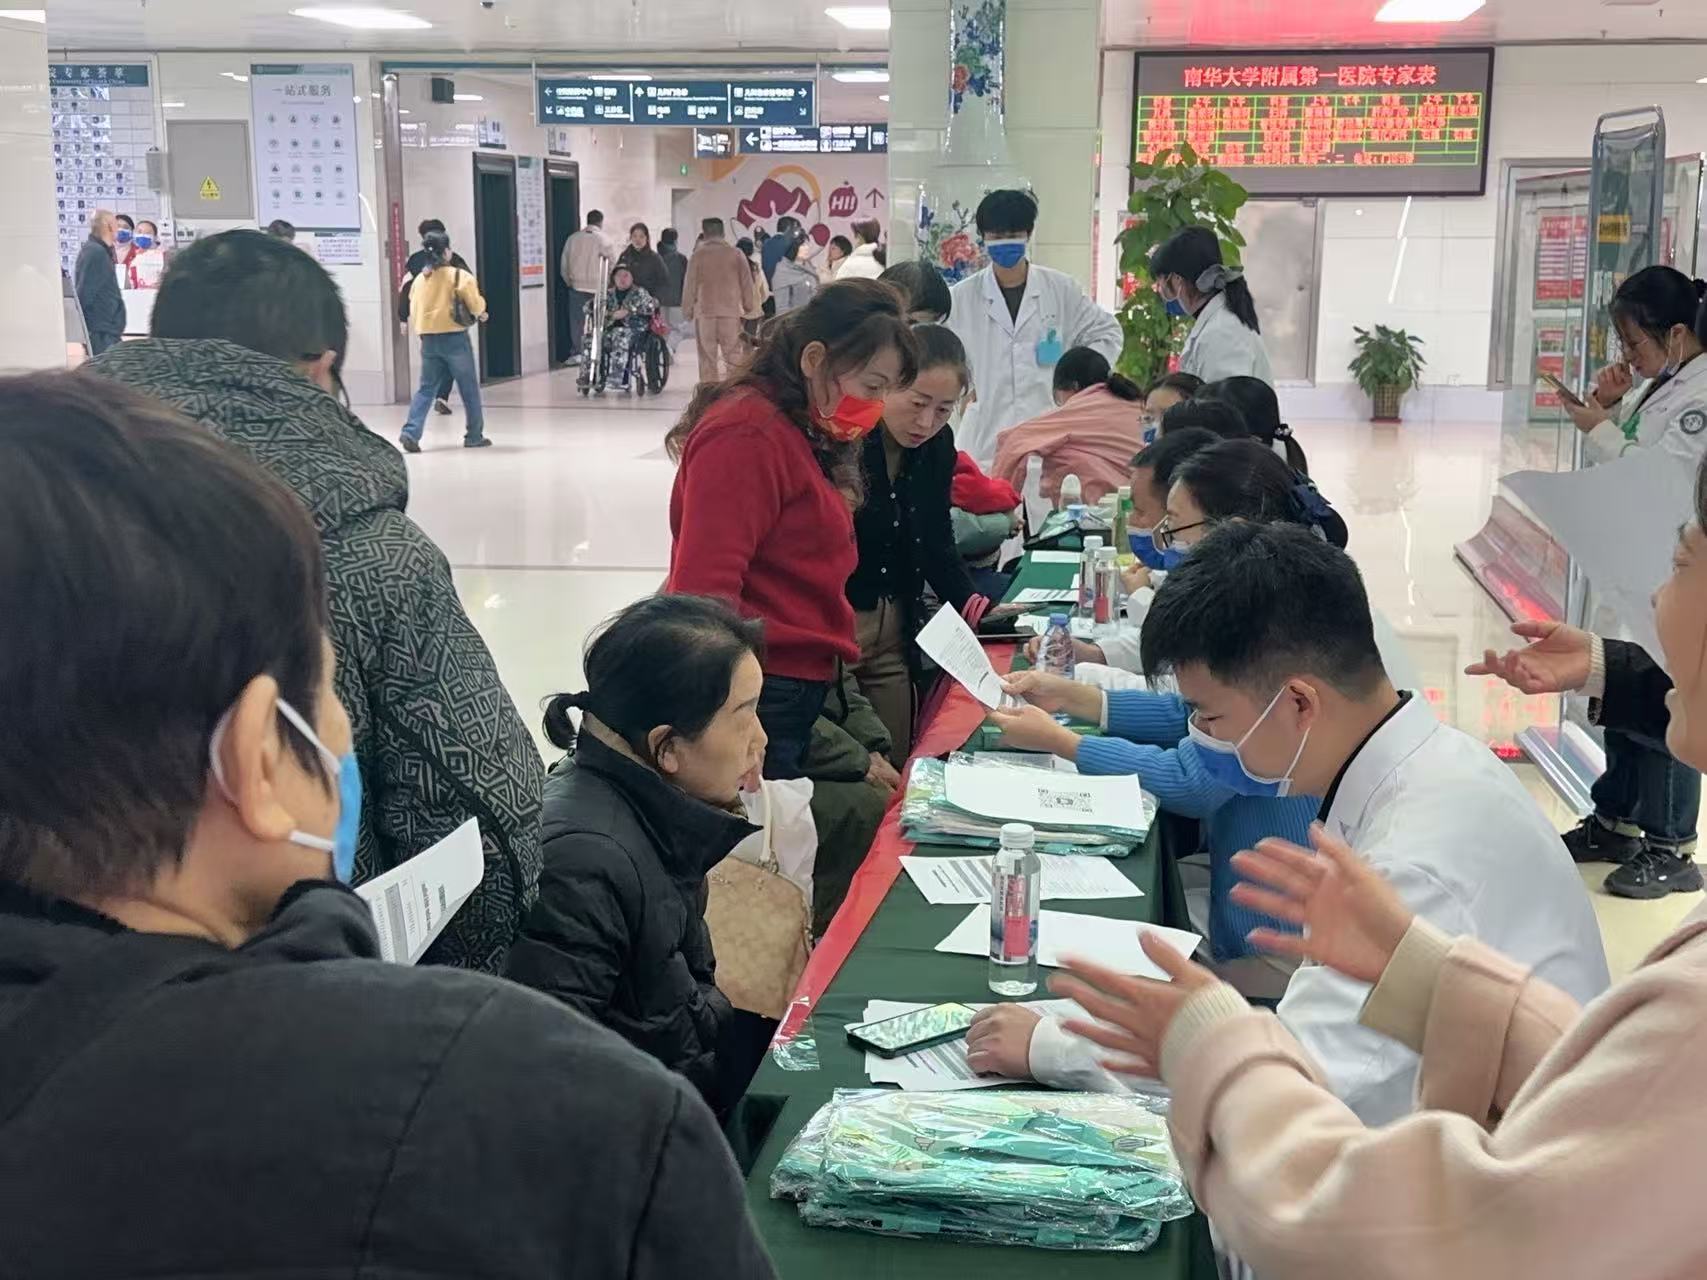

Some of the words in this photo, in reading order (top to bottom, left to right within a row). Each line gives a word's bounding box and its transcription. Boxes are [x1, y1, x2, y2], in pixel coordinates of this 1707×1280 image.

[1183, 64, 1438, 88] 南华大学附属第一医院专家表
[272, 84, 331, 97] 一站式服务
[831, 194, 856, 211] HI!
